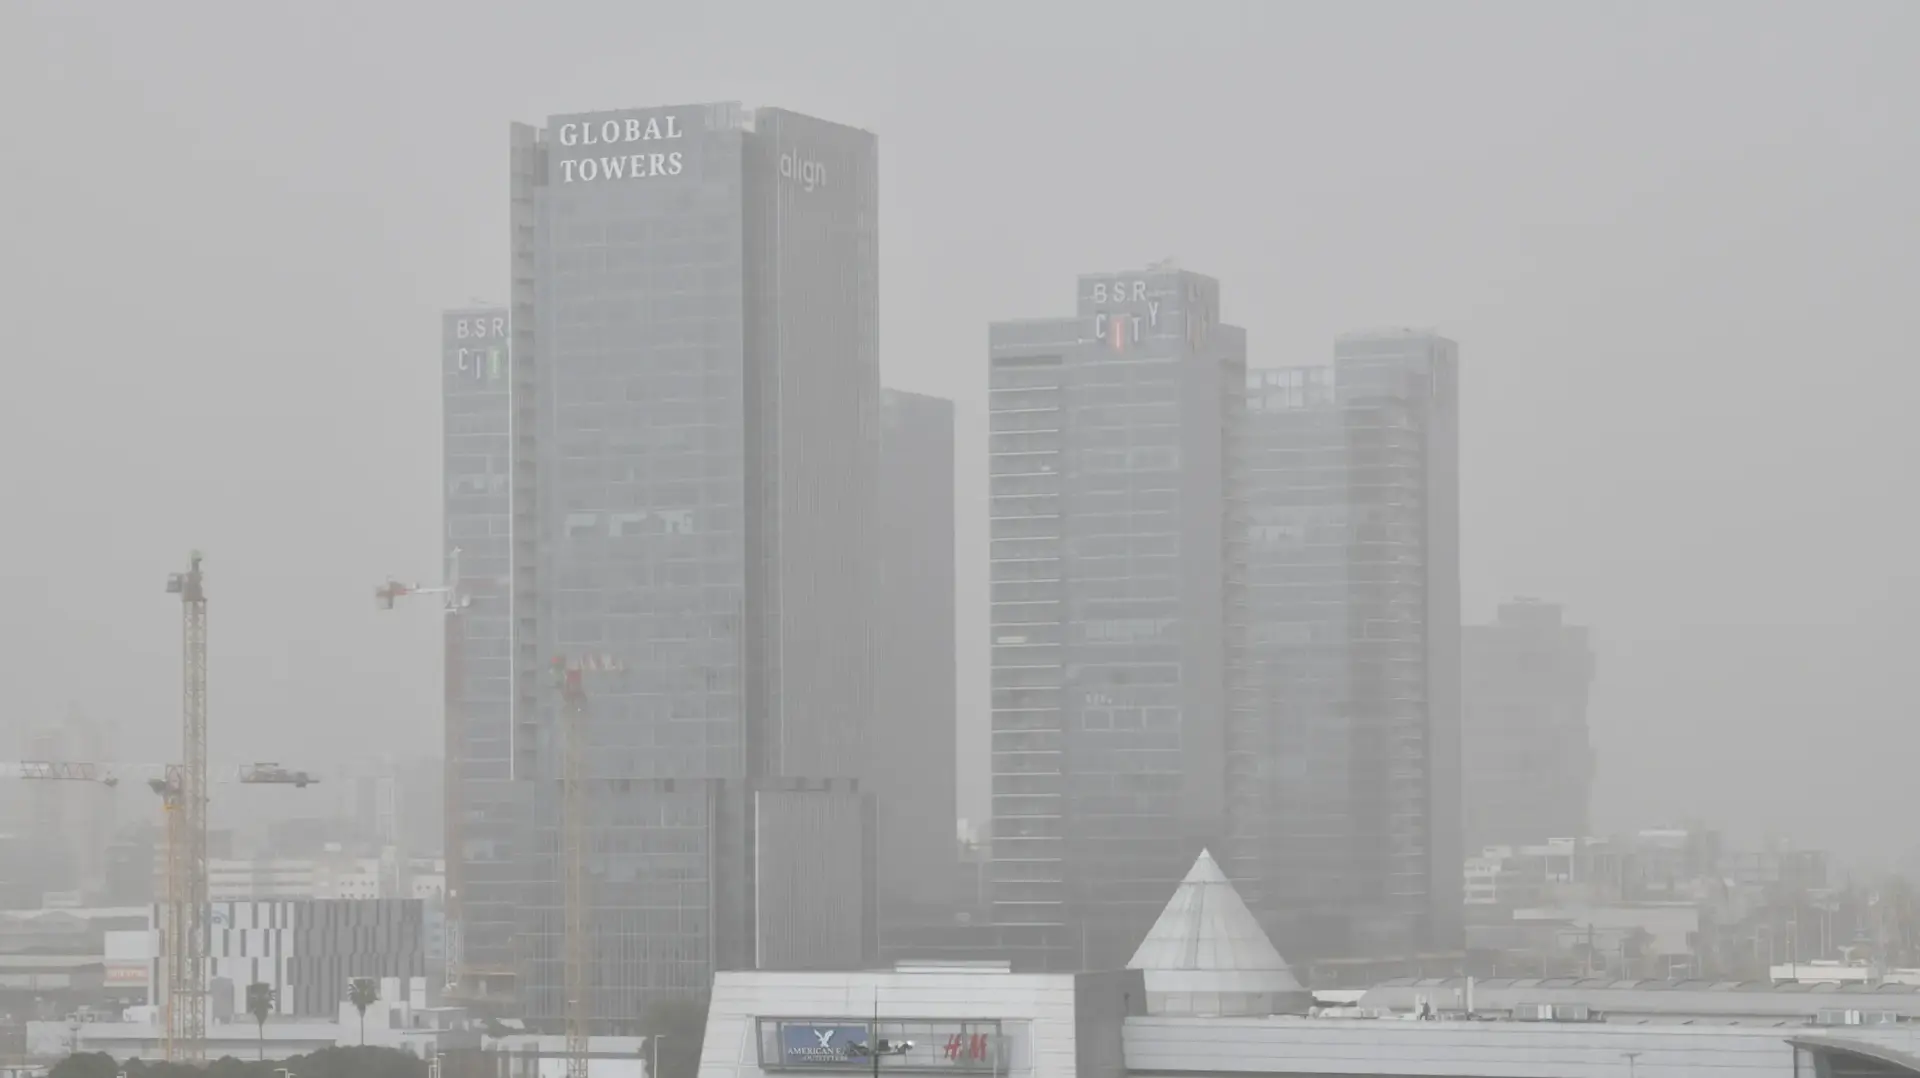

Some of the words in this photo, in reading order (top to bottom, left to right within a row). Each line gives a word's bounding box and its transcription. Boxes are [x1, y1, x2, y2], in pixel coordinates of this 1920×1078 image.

[559, 115, 683, 146] GLOBAL
[560, 151, 683, 184] TOWERS
[780, 148, 827, 192] align
[1096, 301, 1160, 349] CITY
[458, 347, 502, 379] CIT
[788, 1047, 834, 1055] AMERICAN
